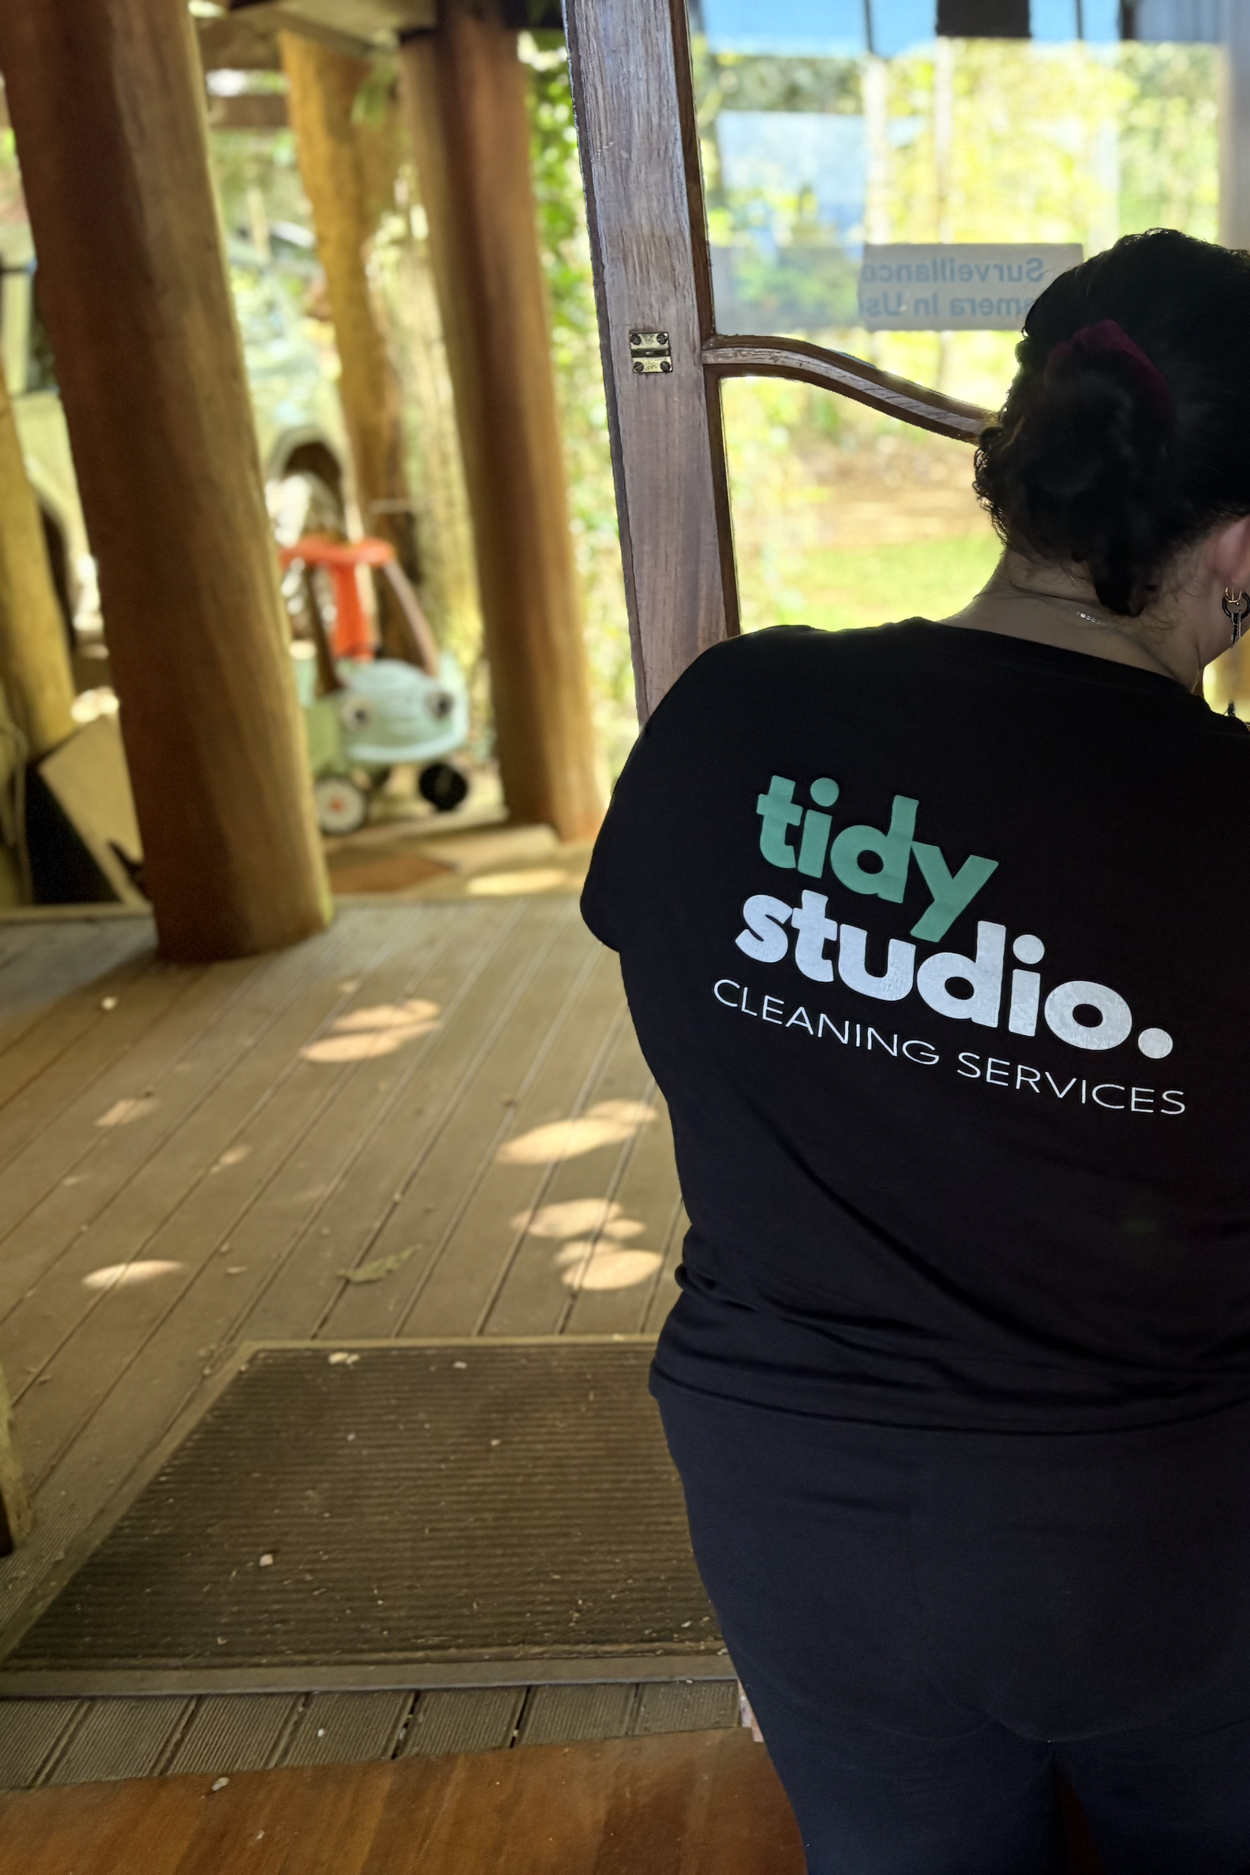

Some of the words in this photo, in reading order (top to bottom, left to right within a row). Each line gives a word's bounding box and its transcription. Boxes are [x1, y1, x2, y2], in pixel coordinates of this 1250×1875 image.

[756, 775, 999, 942] tidy
[713, 978, 940, 1065] CLEANING
[956, 1051, 1186, 1115] SERVICES
[735, 889, 1173, 1059] studio.
